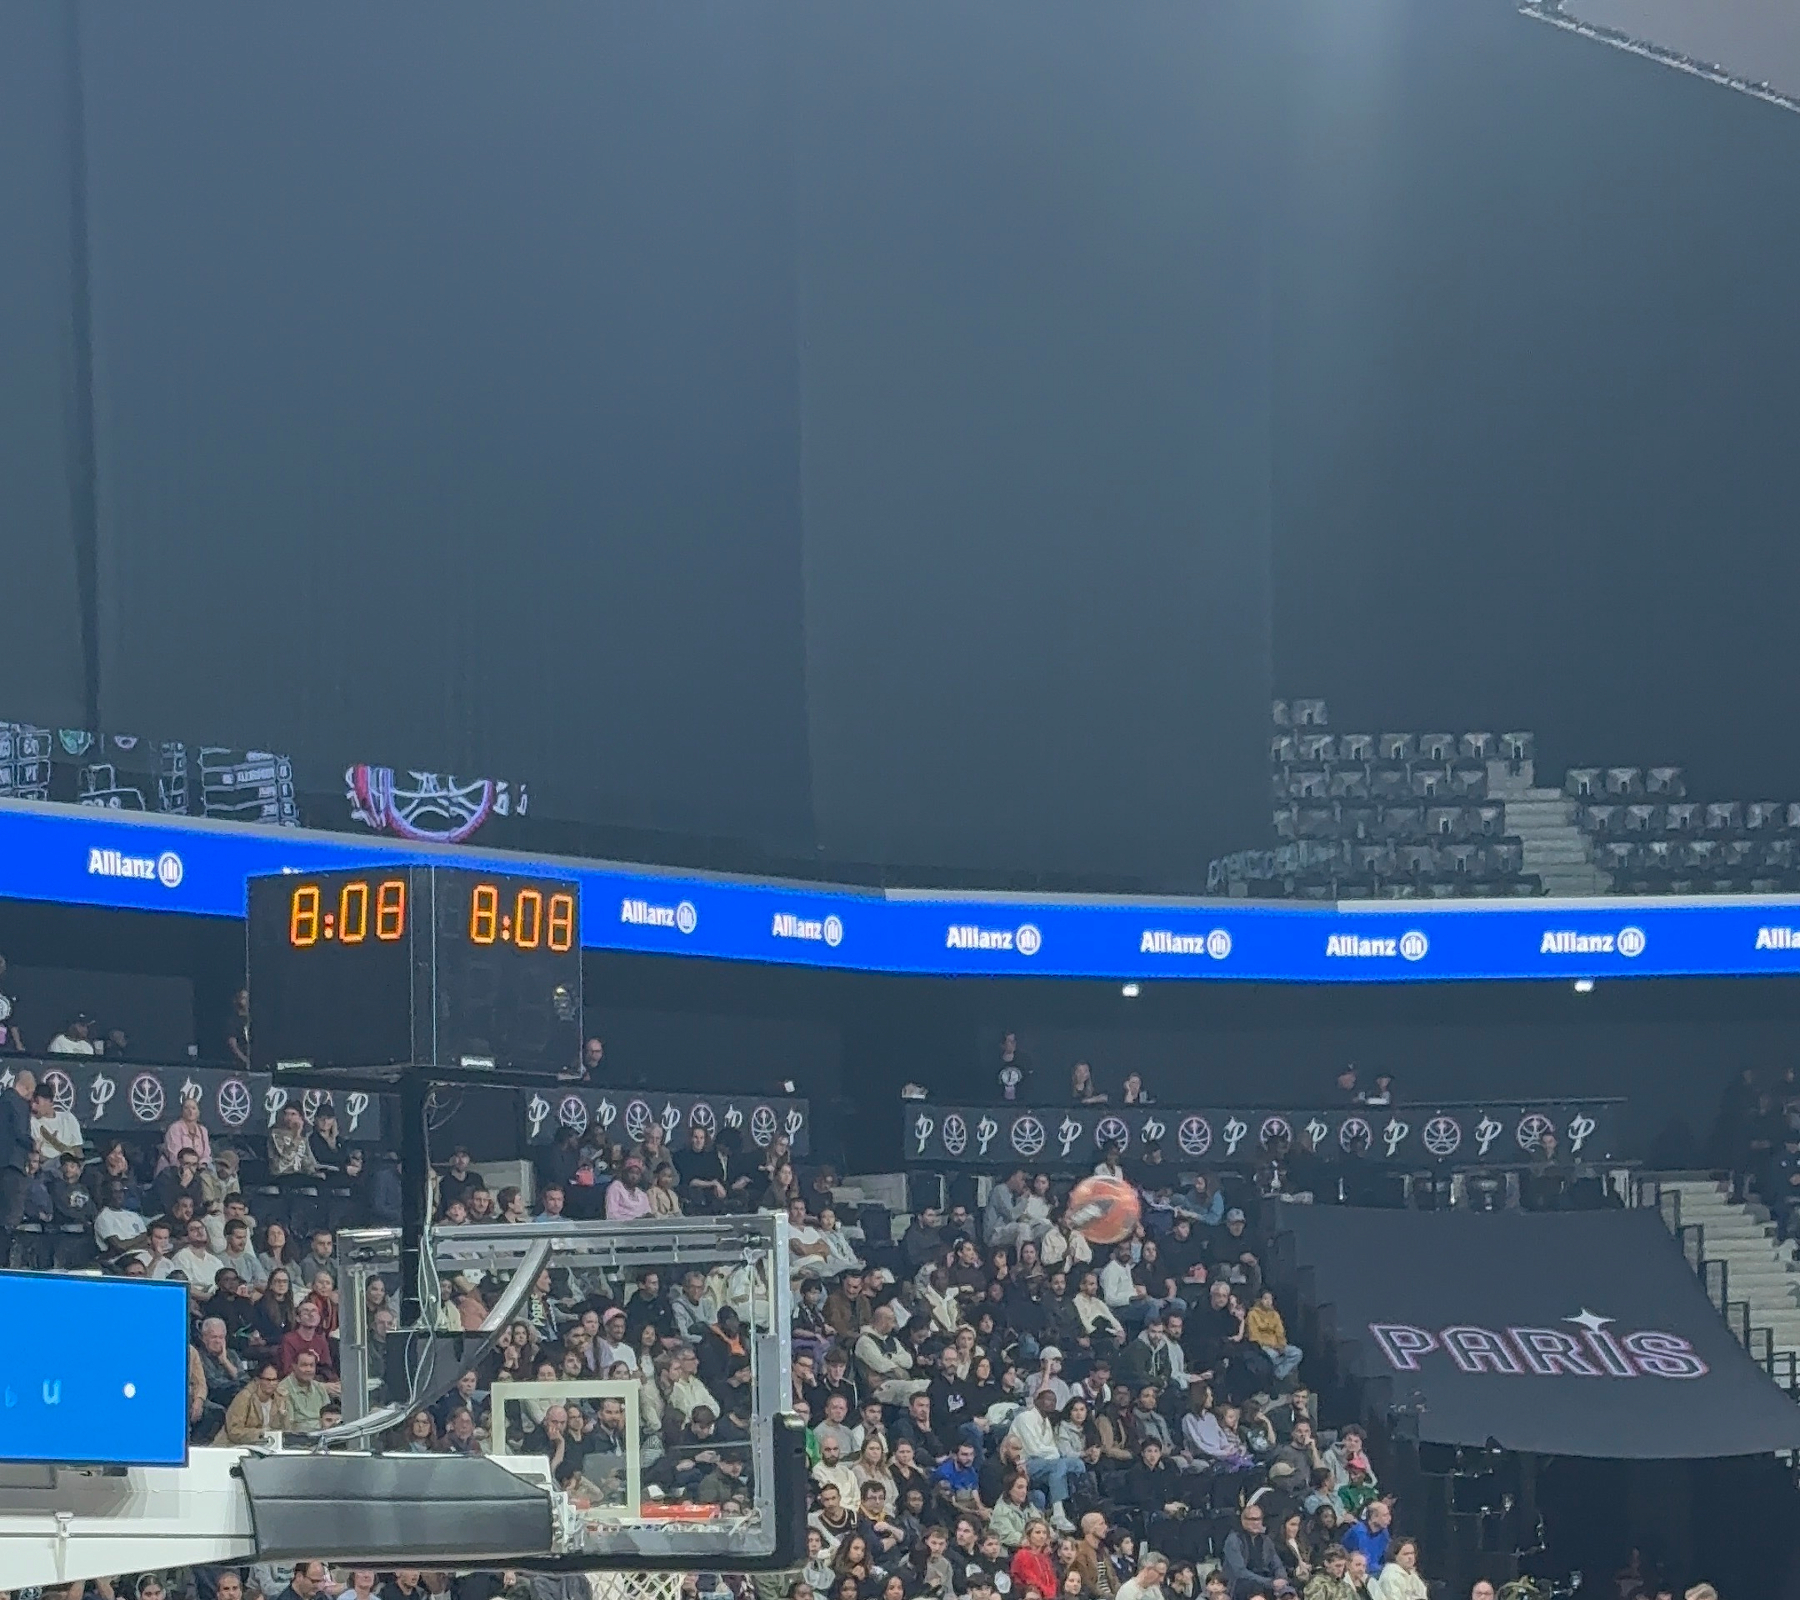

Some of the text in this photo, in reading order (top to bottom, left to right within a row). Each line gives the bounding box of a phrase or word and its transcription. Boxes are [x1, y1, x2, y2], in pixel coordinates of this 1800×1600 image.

[88, 849, 156, 879] Allianz
[289, 881, 405, 947] 8:08
[471, 884, 574, 952] 8:08
[621, 899, 675, 927] Allianz
[772, 914, 823, 941] Allianz
[946, 926, 1013, 951] Allianz
[1140, 930, 1205, 955] Allianz
[1326, 934, 1397, 958] Allianz
[1540, 931, 1615, 955] Allianz
[1370, 1310, 1708, 1379] PARIS
